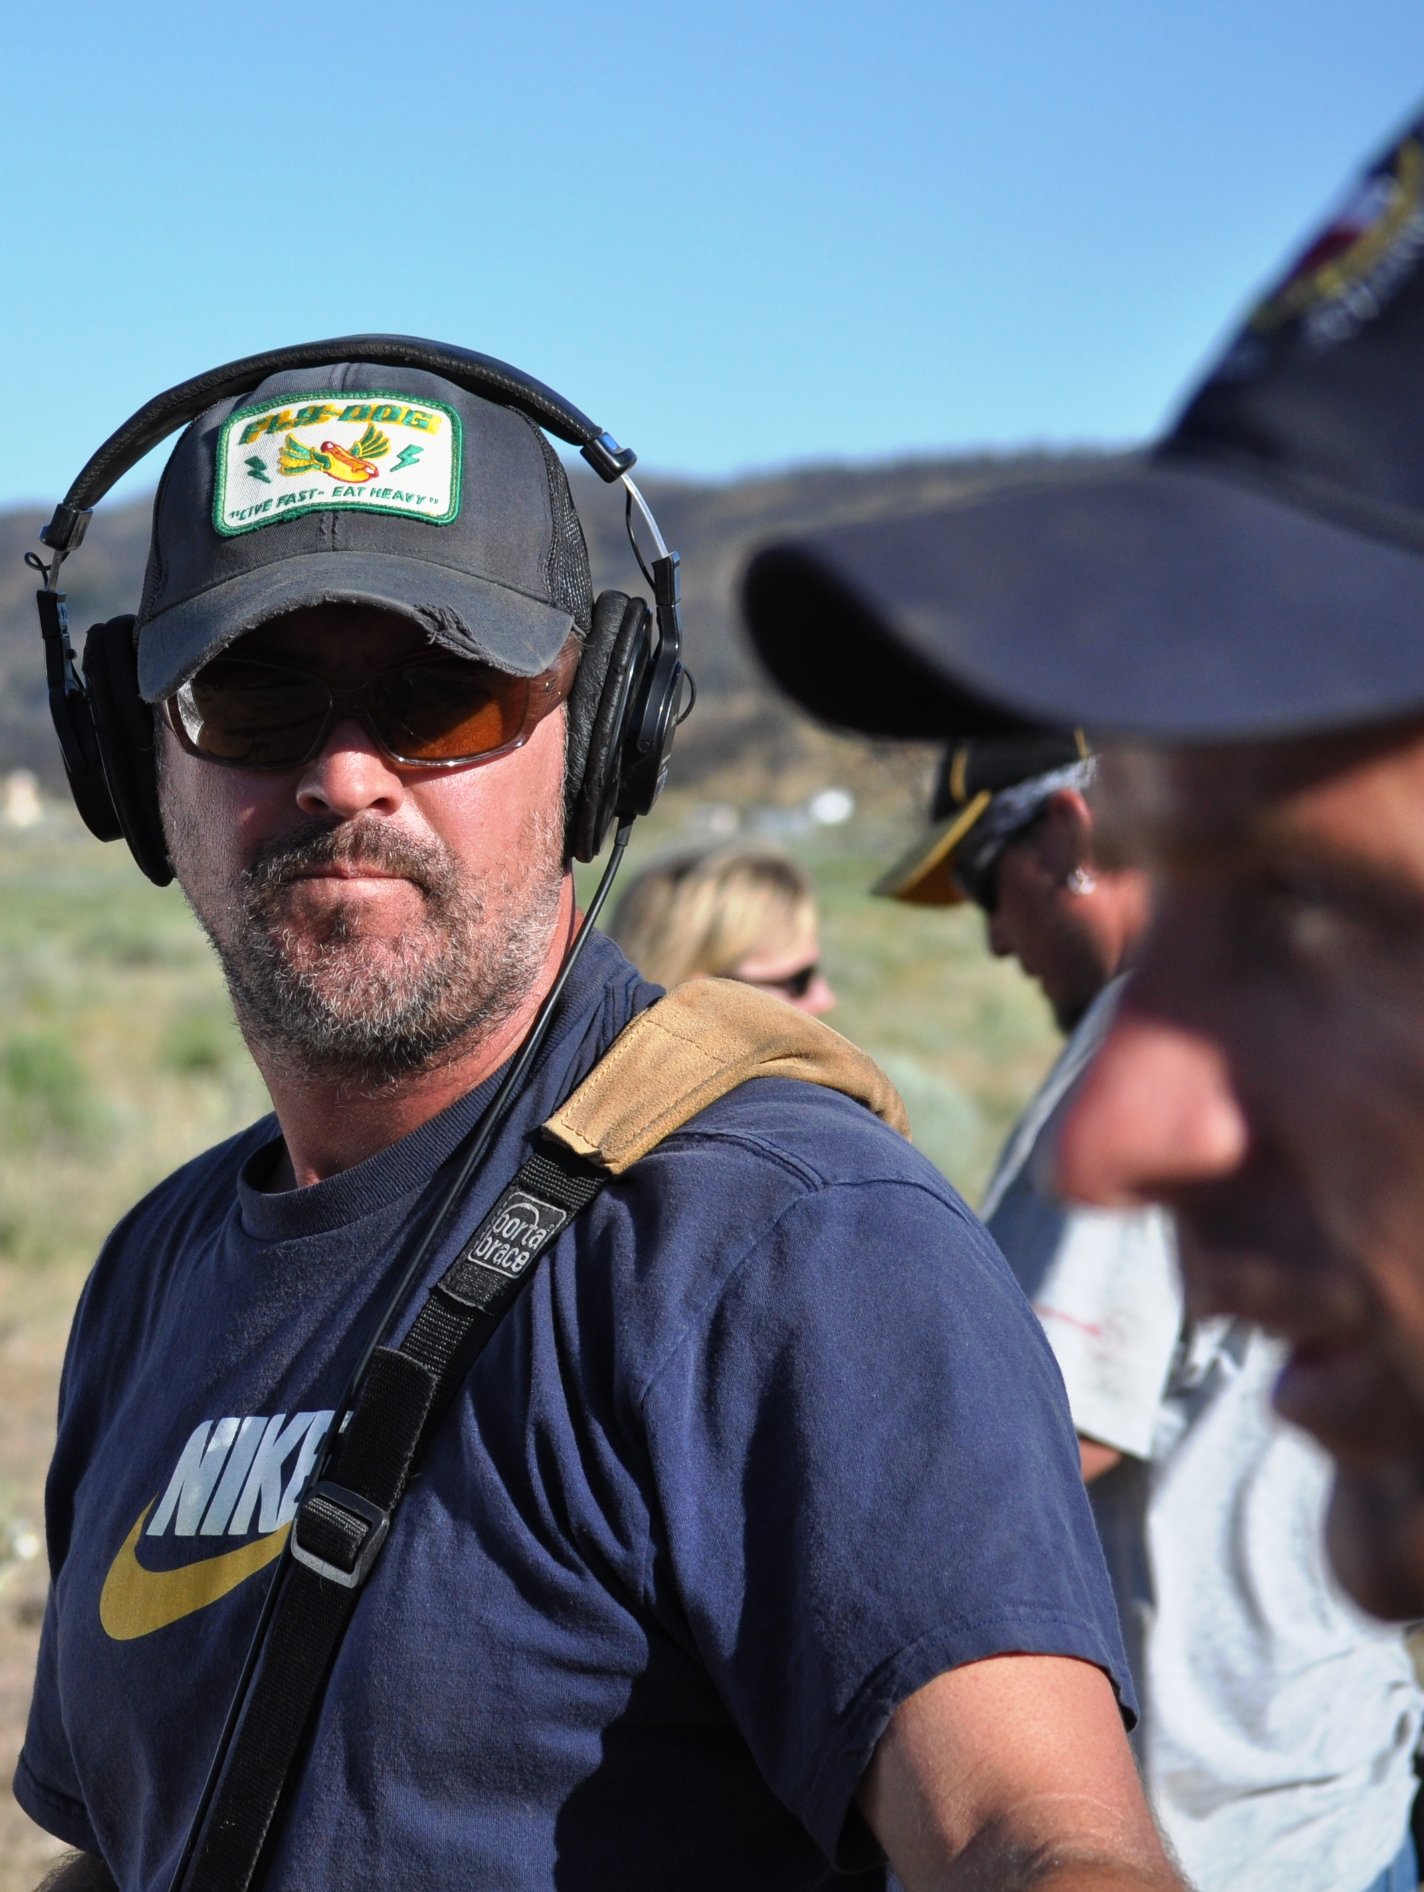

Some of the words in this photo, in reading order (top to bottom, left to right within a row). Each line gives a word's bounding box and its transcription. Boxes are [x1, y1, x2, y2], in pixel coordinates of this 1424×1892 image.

[238, 404, 441, 446] FLY-DOG
[332, 486, 366, 498] EAT
[476, 1230, 530, 1272] brace
[488, 1213, 547, 1250] porta
[146, 1410, 350, 1536] NIKE
